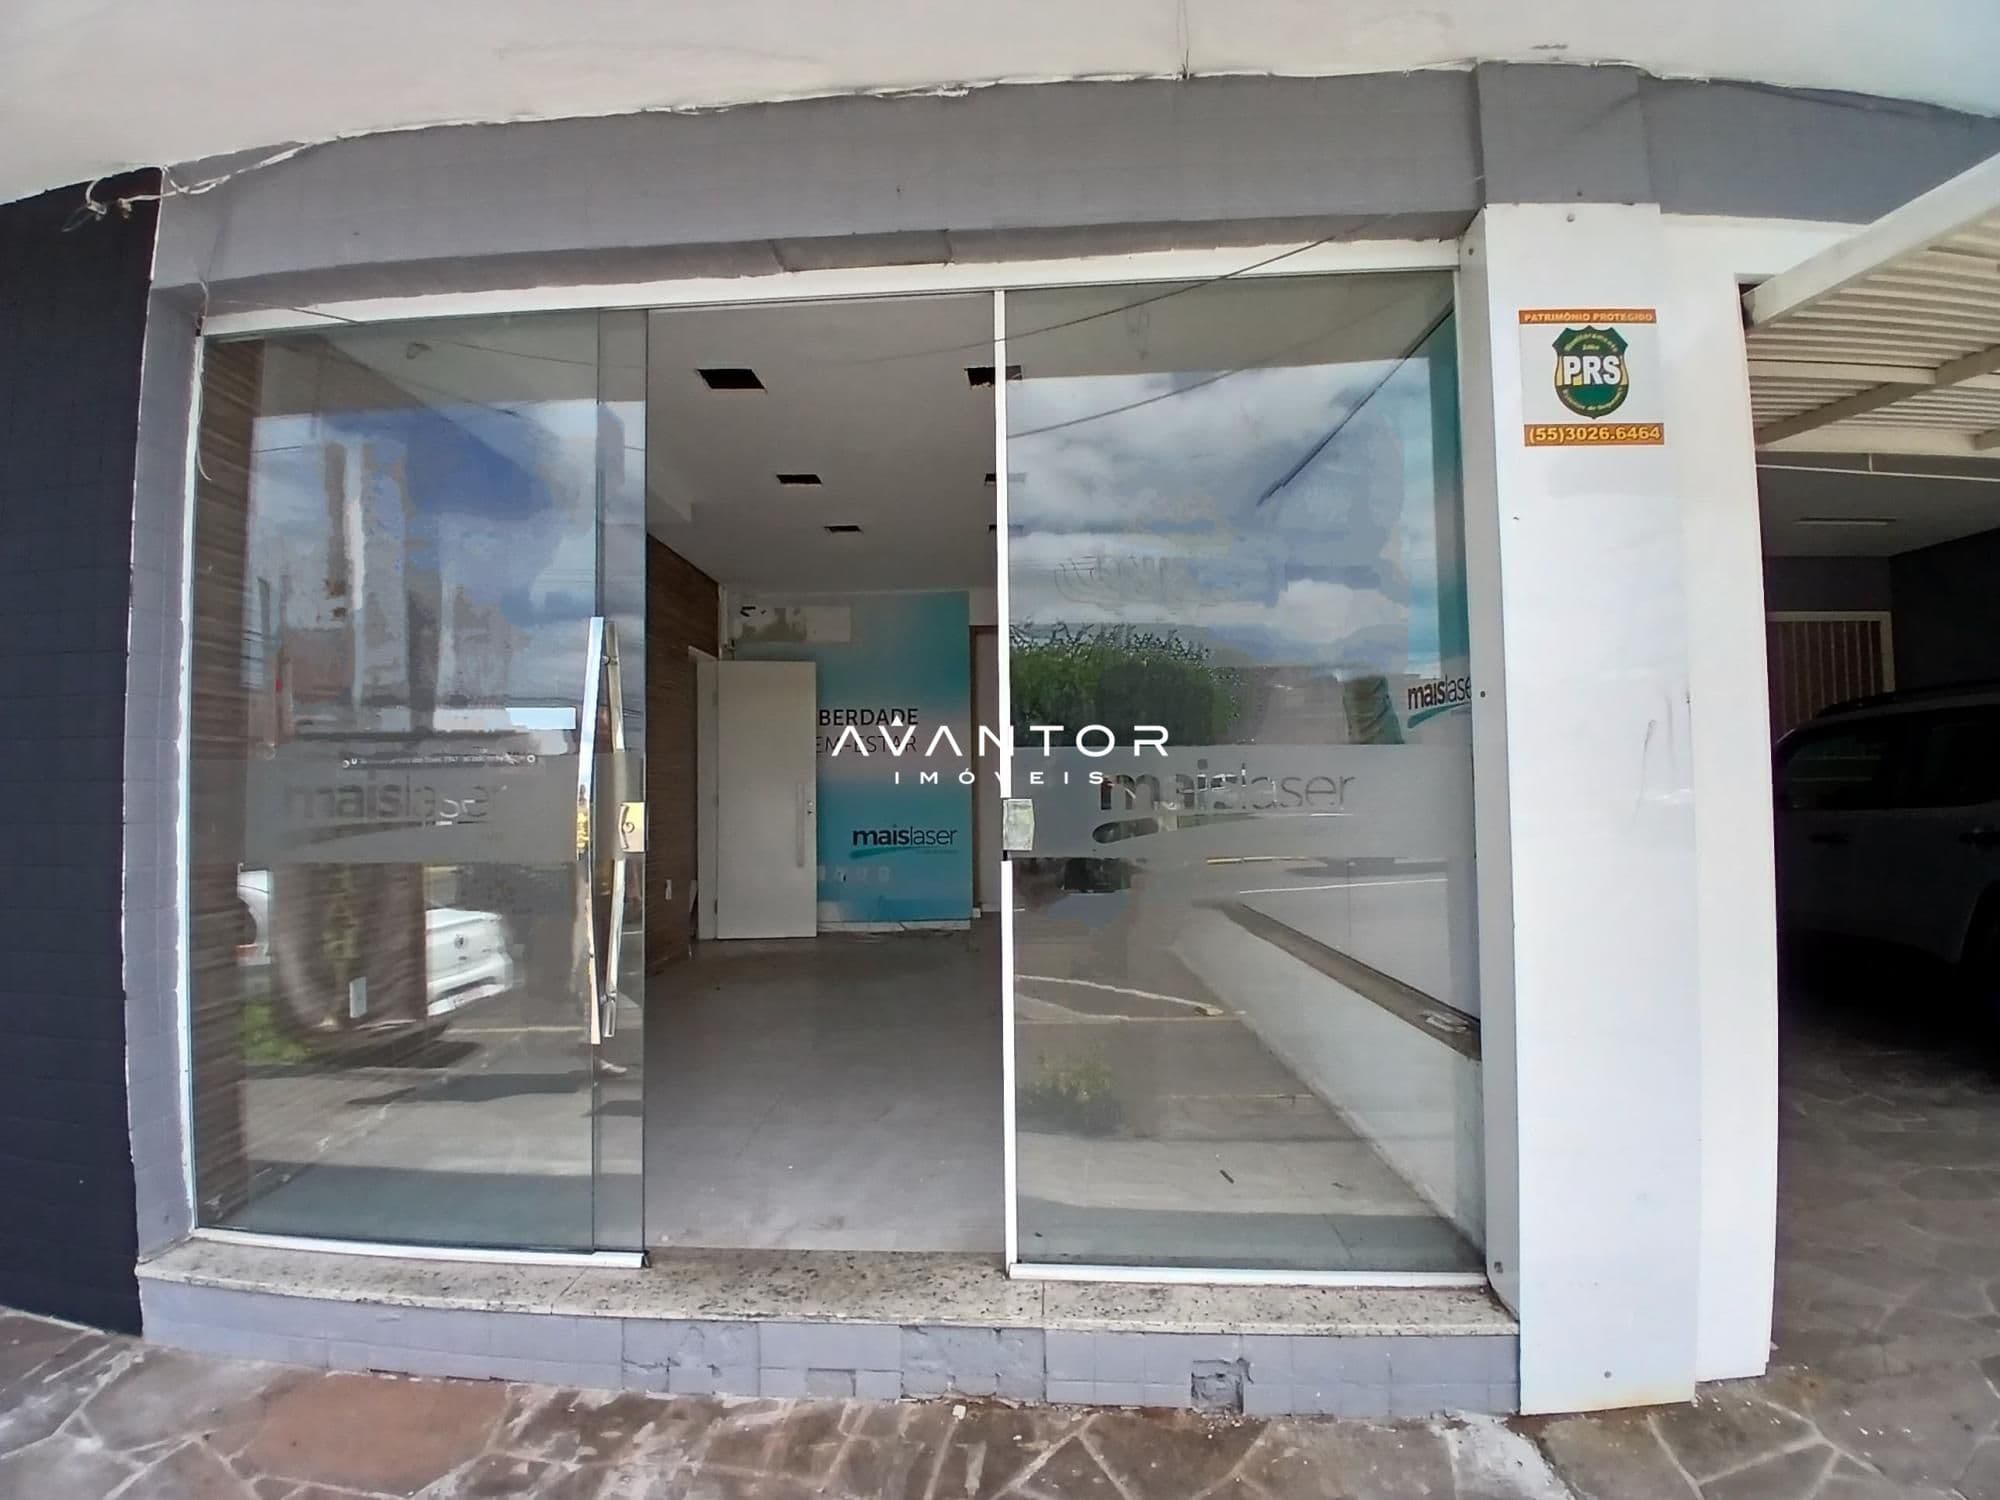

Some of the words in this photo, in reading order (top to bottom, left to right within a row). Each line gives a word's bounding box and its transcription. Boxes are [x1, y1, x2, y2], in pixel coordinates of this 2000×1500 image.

[1563, 355, 1622, 385] PRS
[1529, 427, 1660, 443] (55)3026.6464
[819, 708, 919, 726] BERDADE
[852, 824, 957, 846] maislaser
